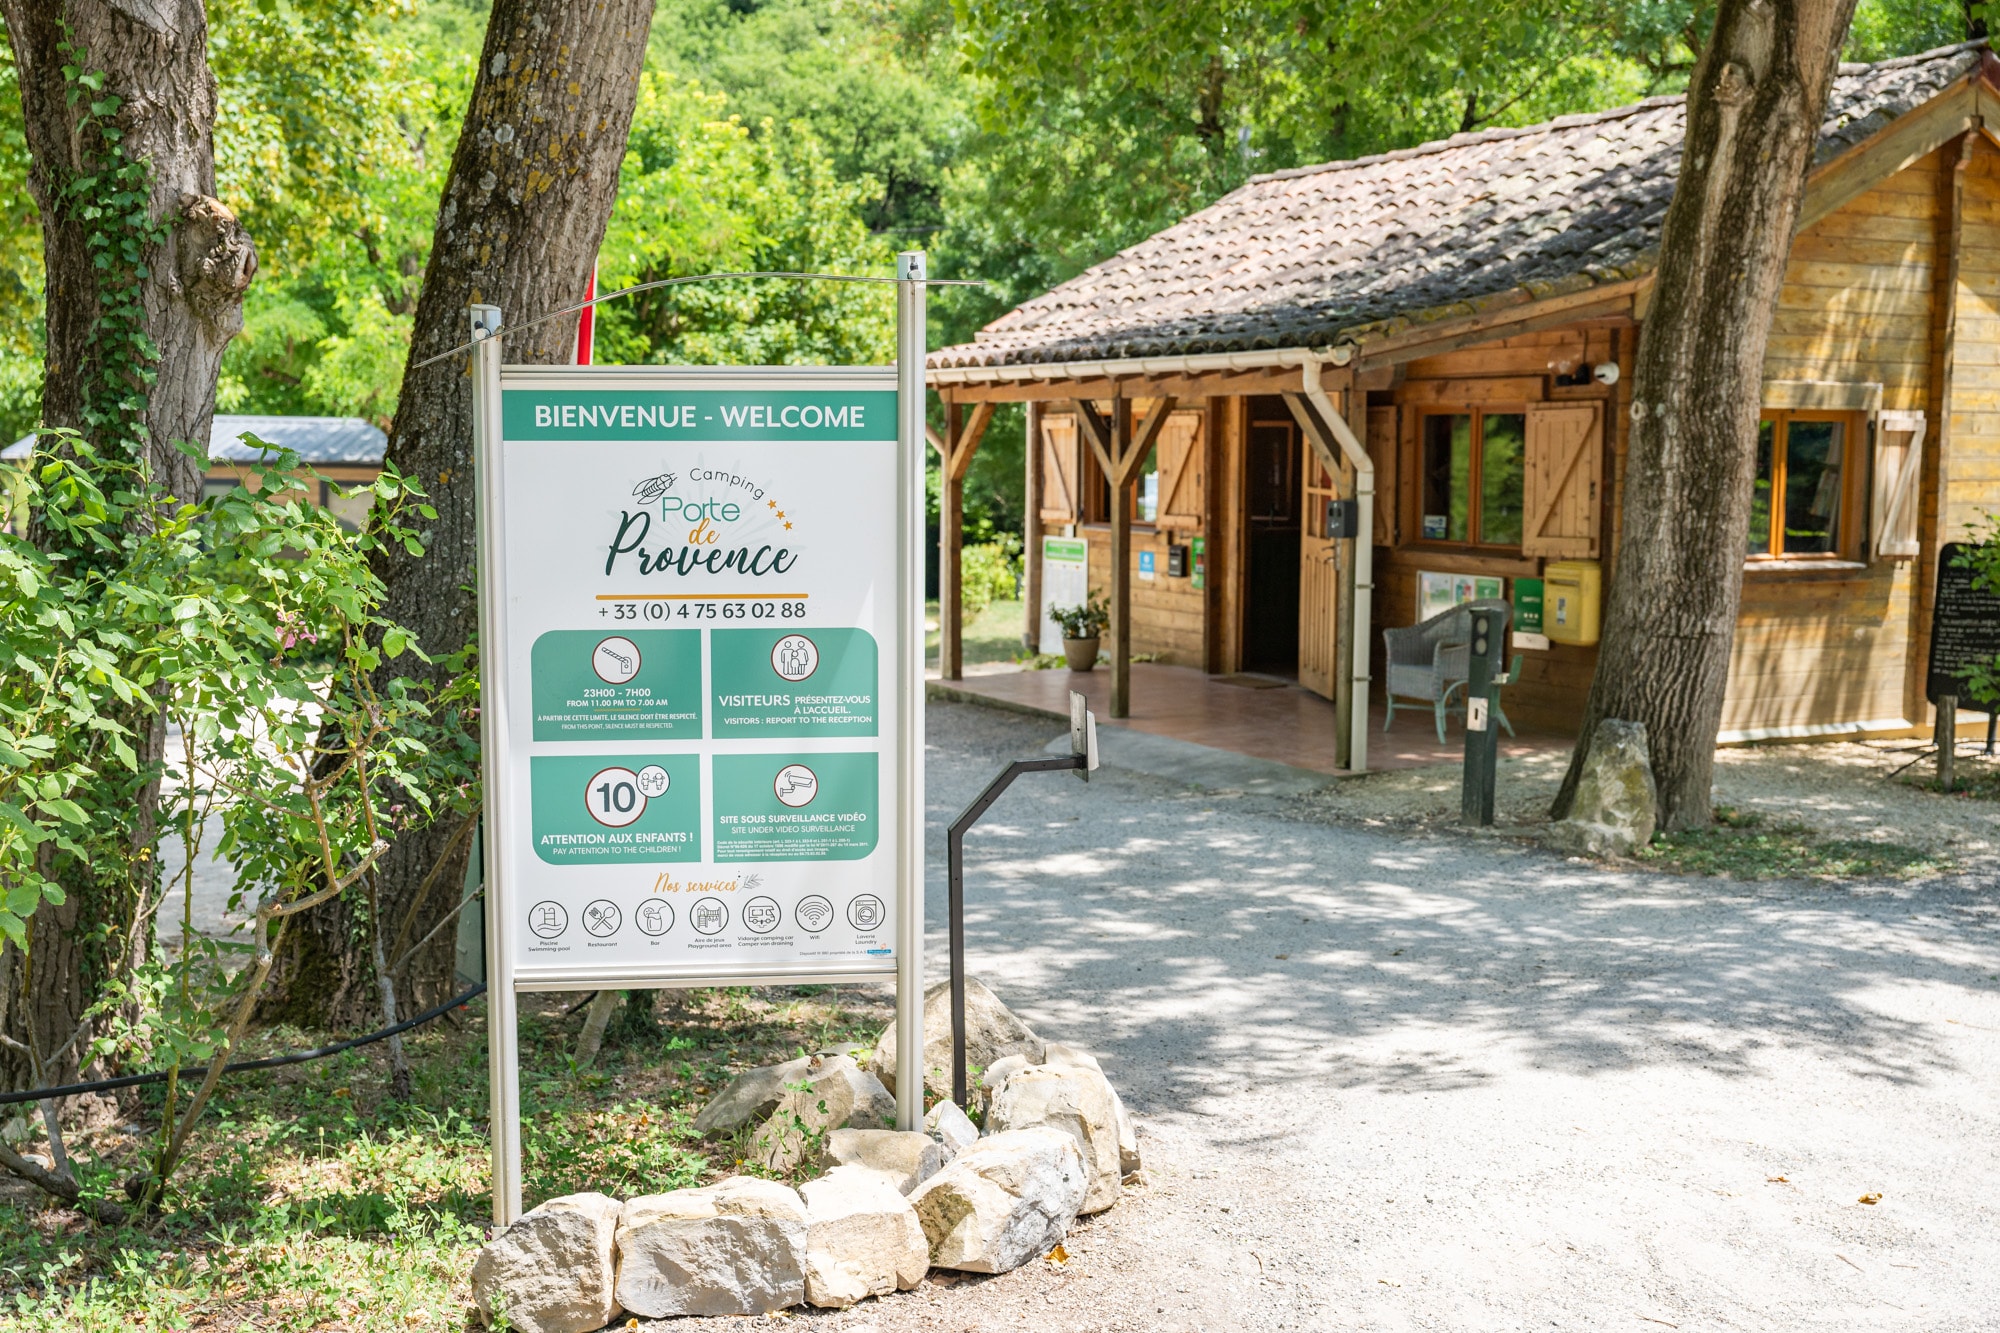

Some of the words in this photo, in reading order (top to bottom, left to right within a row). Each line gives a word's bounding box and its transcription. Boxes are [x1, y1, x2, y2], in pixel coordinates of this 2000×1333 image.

[535, 405, 696, 429] BIENVENUE
[719, 405, 865, 429] WELCOME
[689, 467, 765, 500] Camping
[662, 497, 740, 522] Porte
[688, 517, 720, 545] de
[605, 511, 797, 577] Provence
[614, 603, 637, 619] 33
[643, 601, 671, 622] (0)
[676, 603, 690, 619] 4
[694, 603, 717, 618] 75
[722, 602, 746, 618] 63
[751, 602, 775, 618] 02
[780, 602, 806, 618] 88
[583, 688, 616, 698] 23H00
[625, 688, 651, 697] 7H00
[591, 699, 612, 707] 11.00
[613, 699, 625, 707] PM
[626, 699, 637, 707] TO
[718, 694, 791, 707] VISITEURS
[794, 694, 871, 704] PRÉSENTEZ-VOUS
[793, 704, 801, 714] À
[803, 706, 851, 715] L'ACCUEIL.
[590, 714, 610, 722] LIMITE,
[655, 712, 669, 720] ÊTRE
[669, 712, 698, 720] RESPECTÉ.
[724, 717, 760, 725] VISITORS
[596, 781, 636, 813] 10
[720, 816, 738, 824] SITE
[741, 815, 766, 823] SOUS
[768, 814, 835, 823] SURVEILLANCE
[837, 812, 867, 822] VIDÉO
[731, 826, 747, 834] SITE
[775, 825, 800, 833] VIDEO
[801, 825, 855, 833] SURVEILLANCE
[541, 834, 605, 845] ATTENTION
[608, 833, 633, 844] AUX
[636, 832, 687, 843] ENFANTS
[569, 847, 609, 855] ATTENTION
[624, 846, 637, 854] THE
[639, 845, 678, 853] CHILDREN
[654, 872, 681, 893] Nos
[685, 879, 738, 893] services
